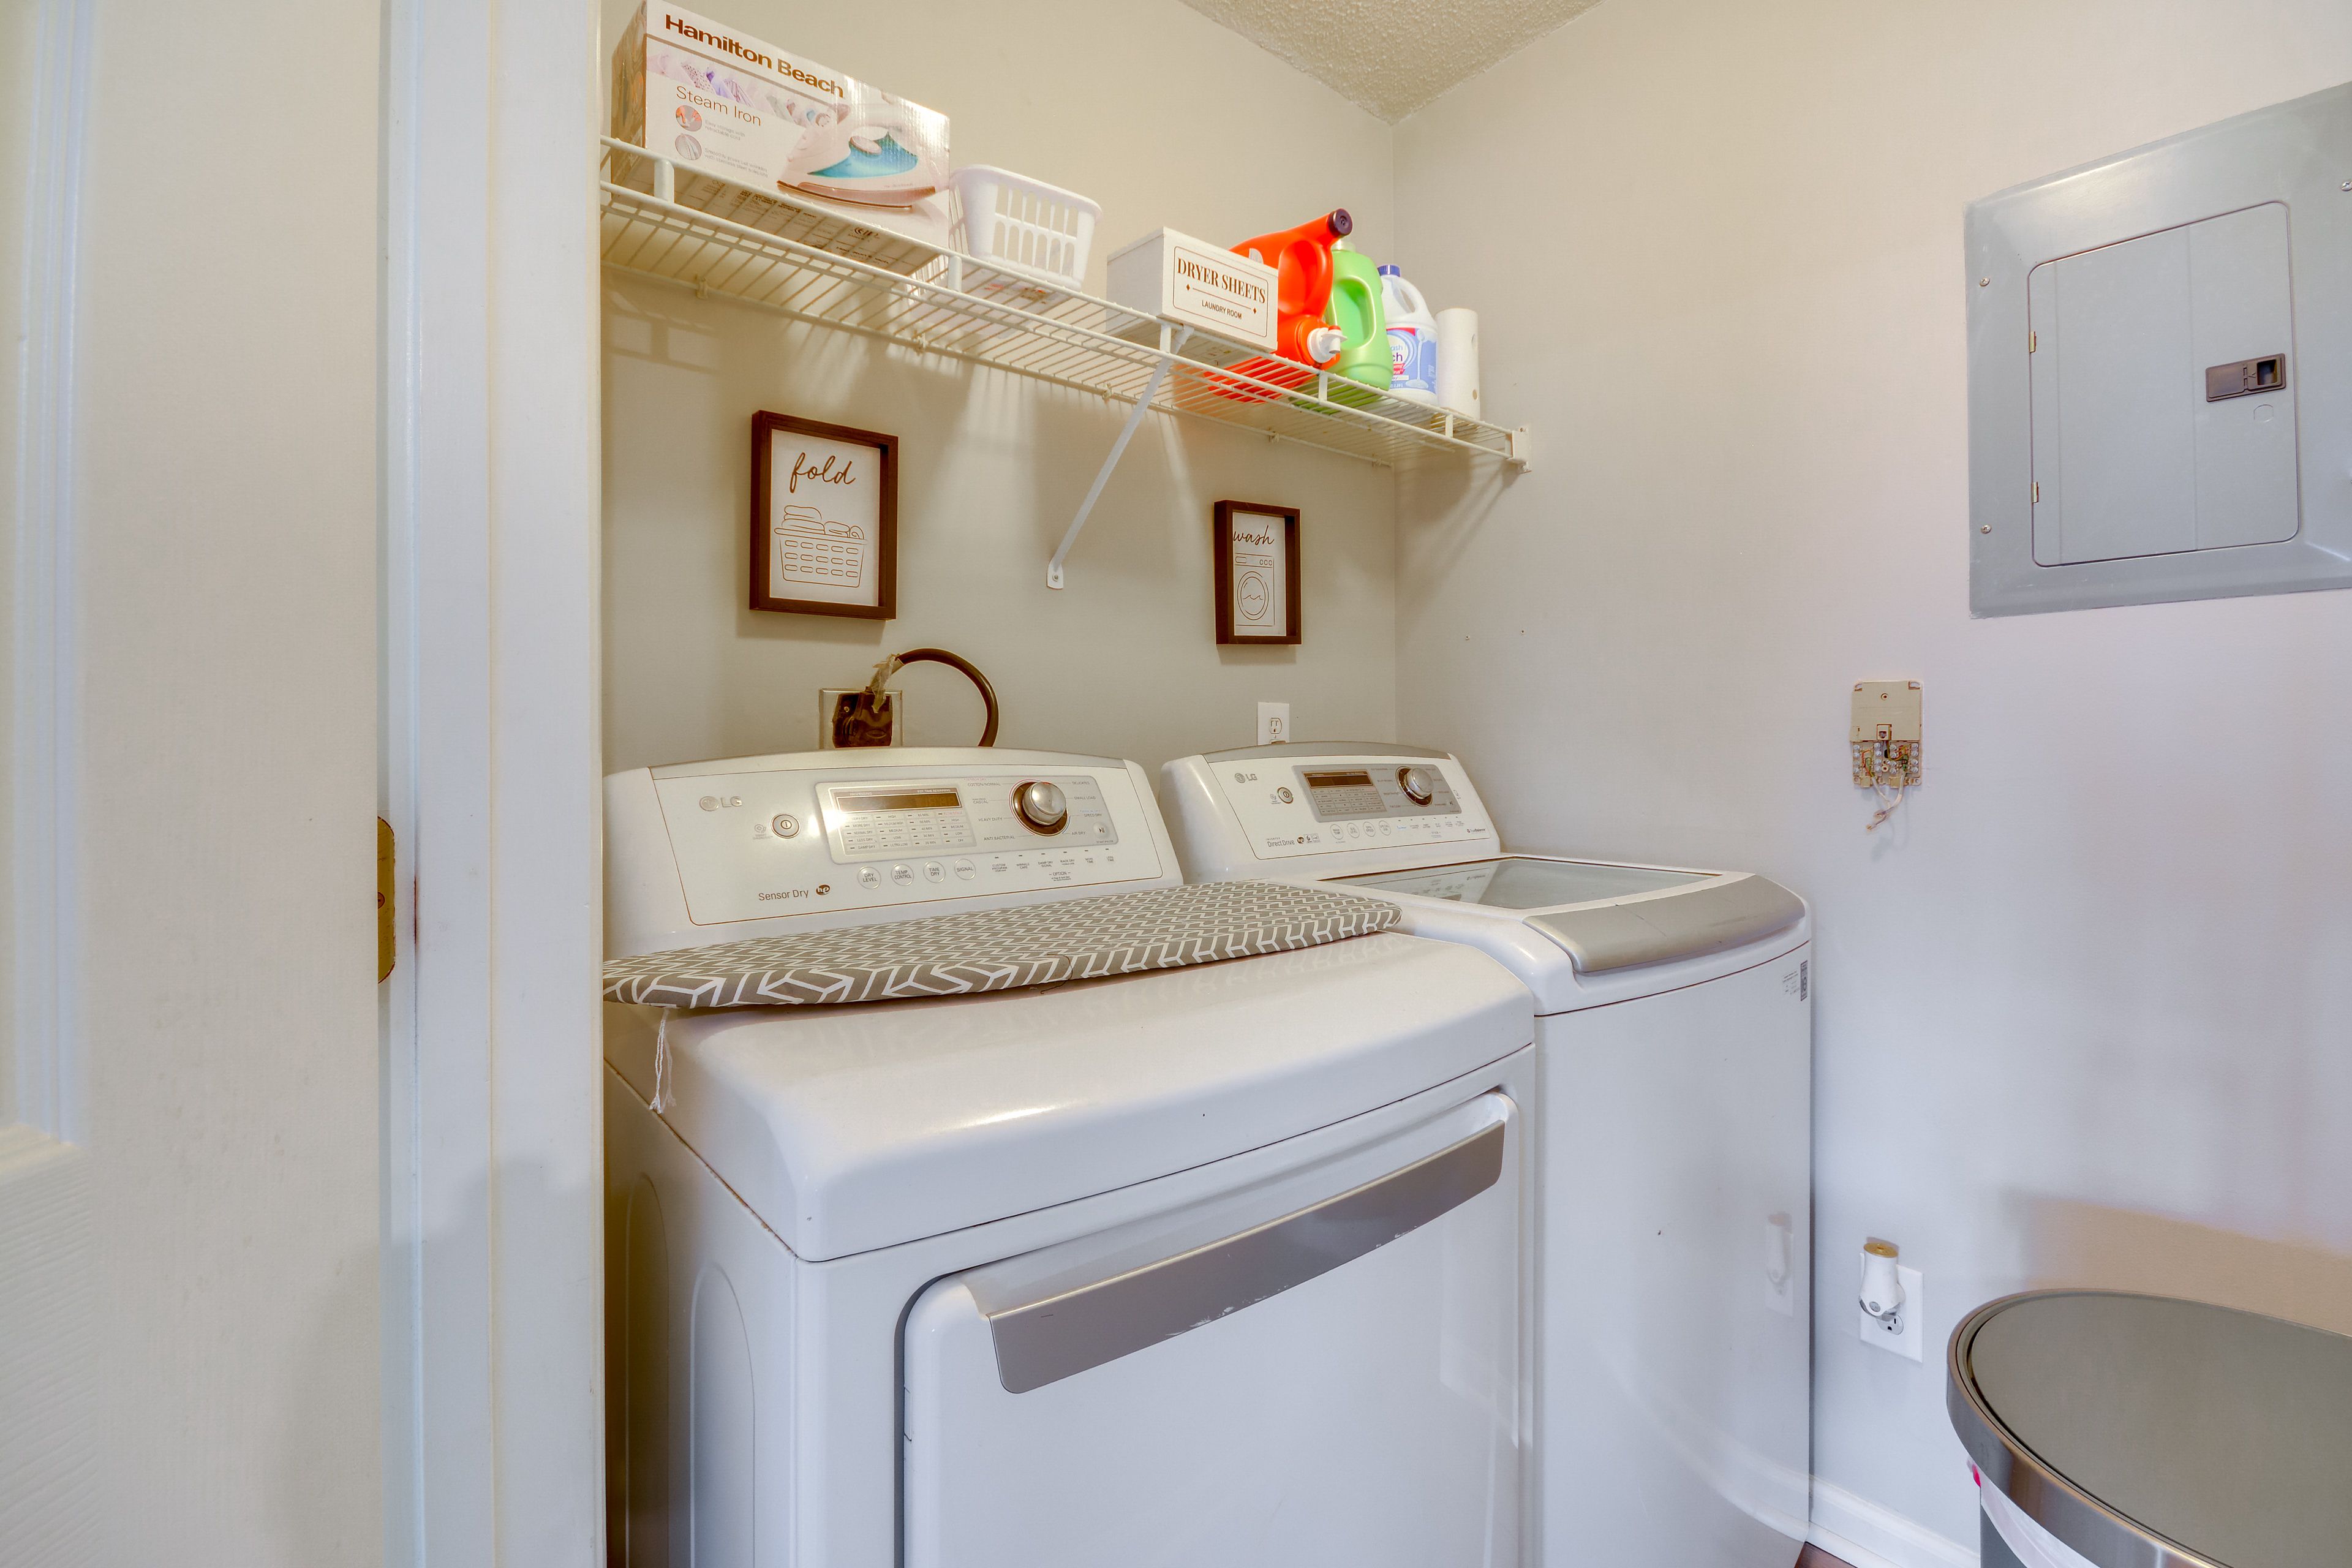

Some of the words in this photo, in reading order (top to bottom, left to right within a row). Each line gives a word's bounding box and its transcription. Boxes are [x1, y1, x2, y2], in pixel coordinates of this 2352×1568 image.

[665, 13, 772, 69] Hamilton
[777, 58, 844, 98] Beach
[676, 86, 728, 115] Steam
[734, 105, 761, 126] Iron
[1177, 257, 1219, 287] DRYER
[1221, 274, 1265, 304] SHEETS
[1202, 300, 1226, 314] LAUNDRY
[1227, 308, 1242, 320] ROOM
[790, 452, 856, 493] fold
[1233, 524, 1275, 546] wash
[720, 796, 742, 807] LG
[758, 891, 790, 901] Sensor
[793, 889, 809, 898] Dry
